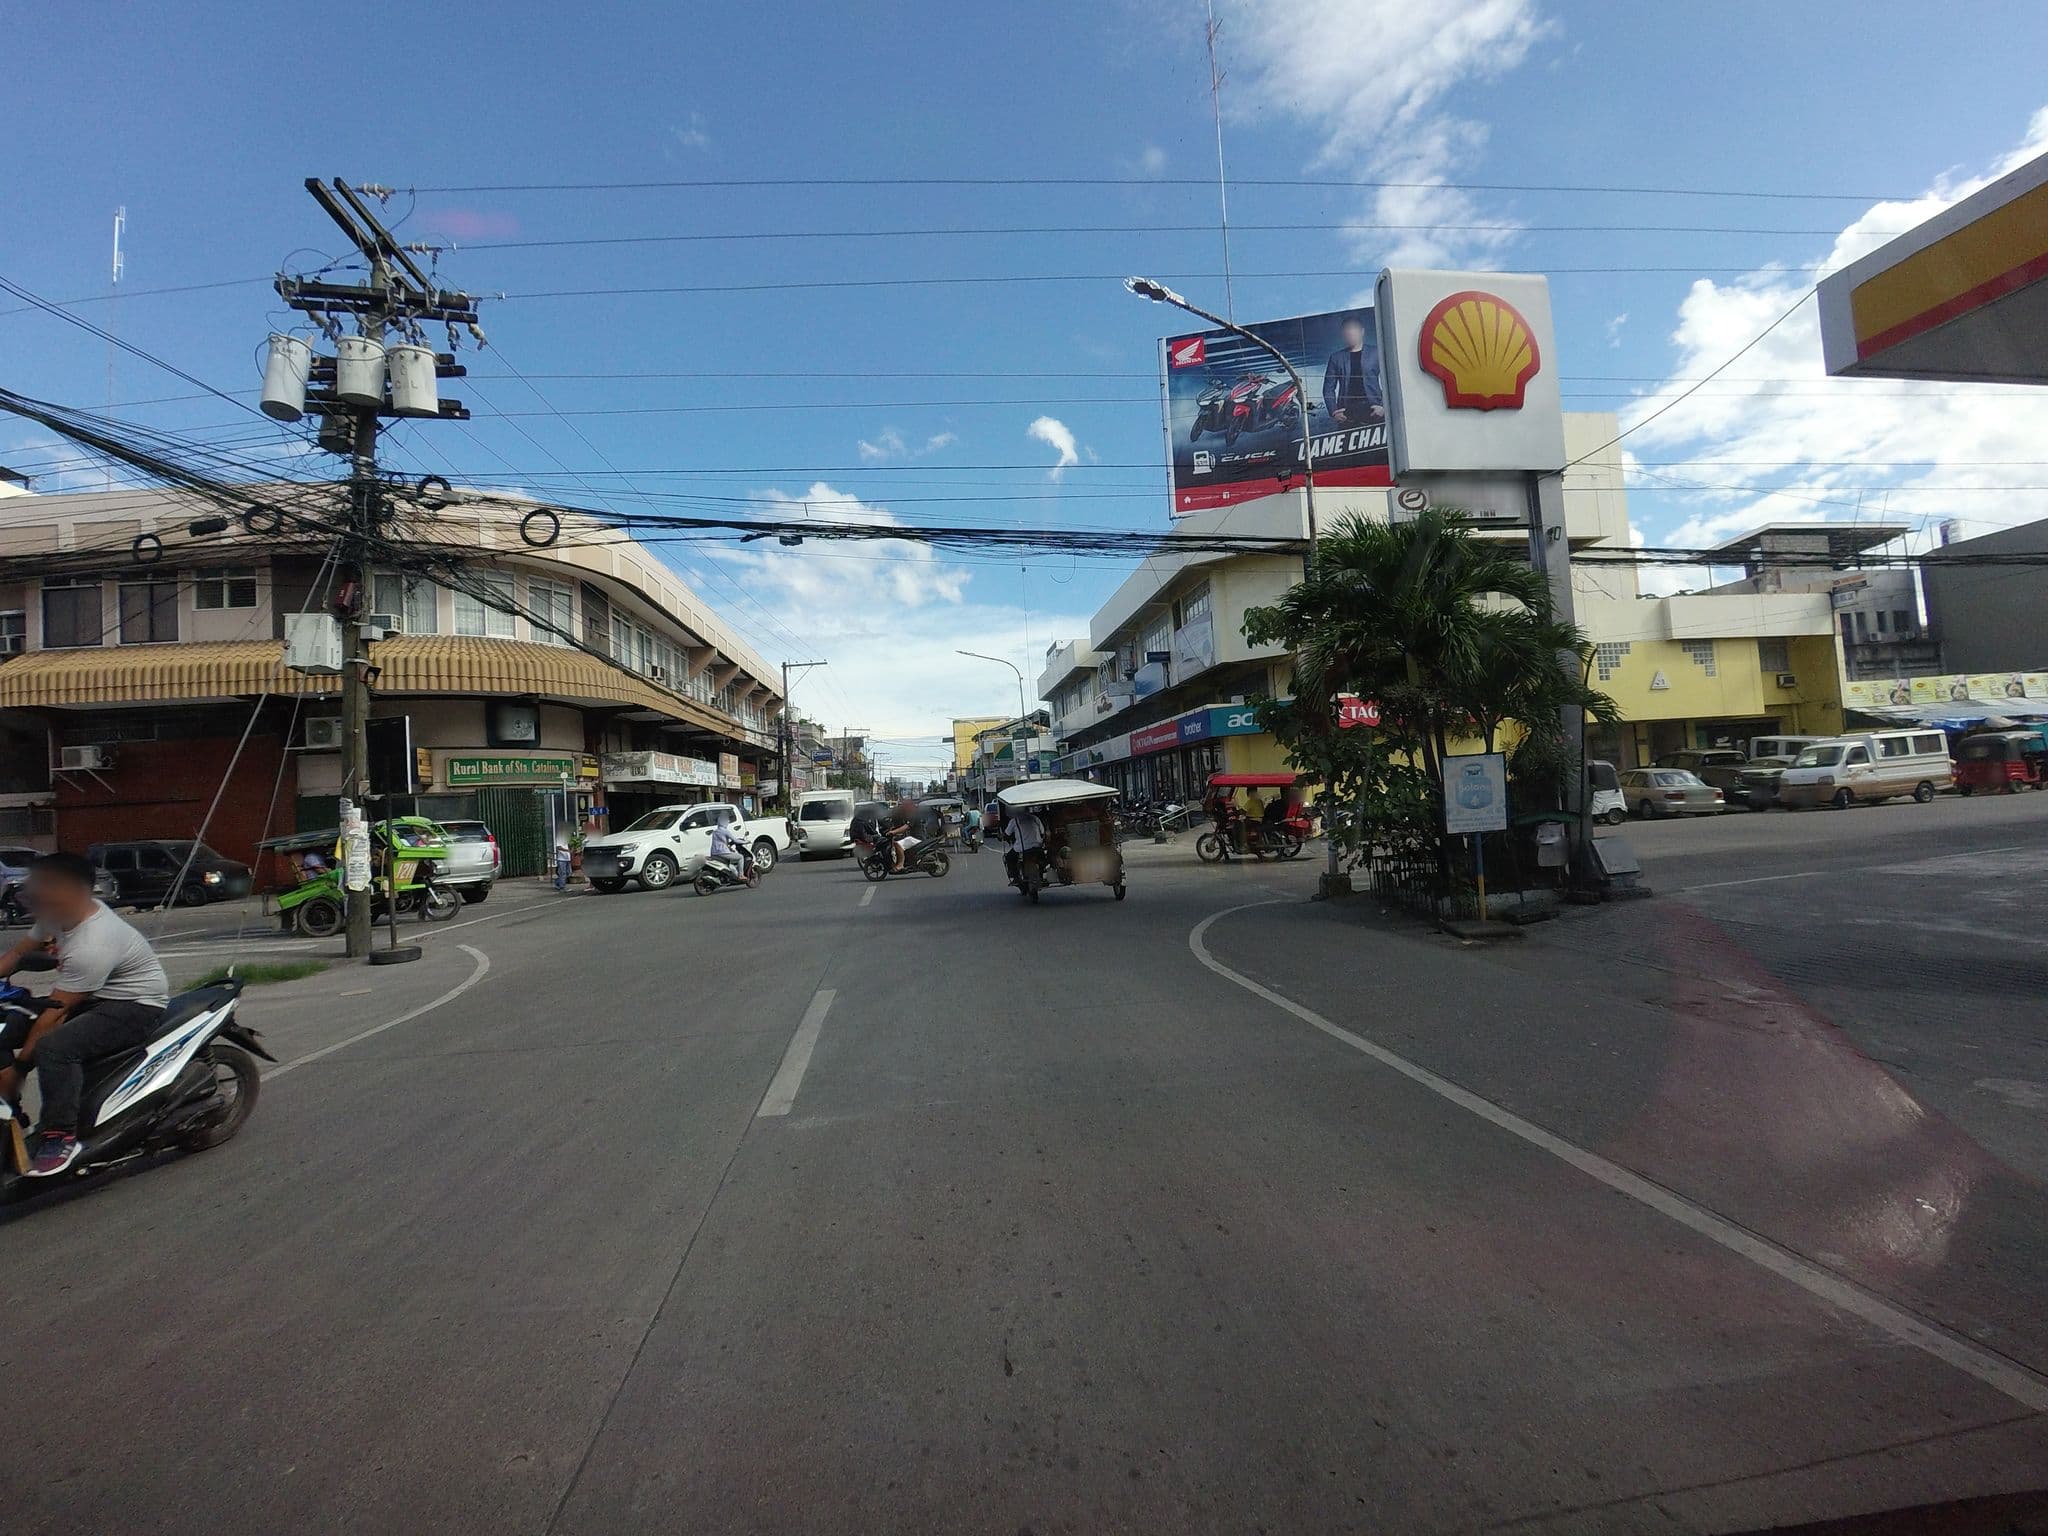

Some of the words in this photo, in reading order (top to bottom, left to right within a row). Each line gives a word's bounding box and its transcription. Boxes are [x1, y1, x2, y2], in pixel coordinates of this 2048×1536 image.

[1175, 357, 1202, 366] HONDA
[1227, 712, 1260, 728] ac
[1338, 705, 1379, 719] CTAG
[1183, 720, 1203, 736] brother
[453, 760, 480, 776] Rural
[482, 759, 503, 774] Bank
[505, 759, 515, 773] of
[515, 760, 530, 773] Sta.
